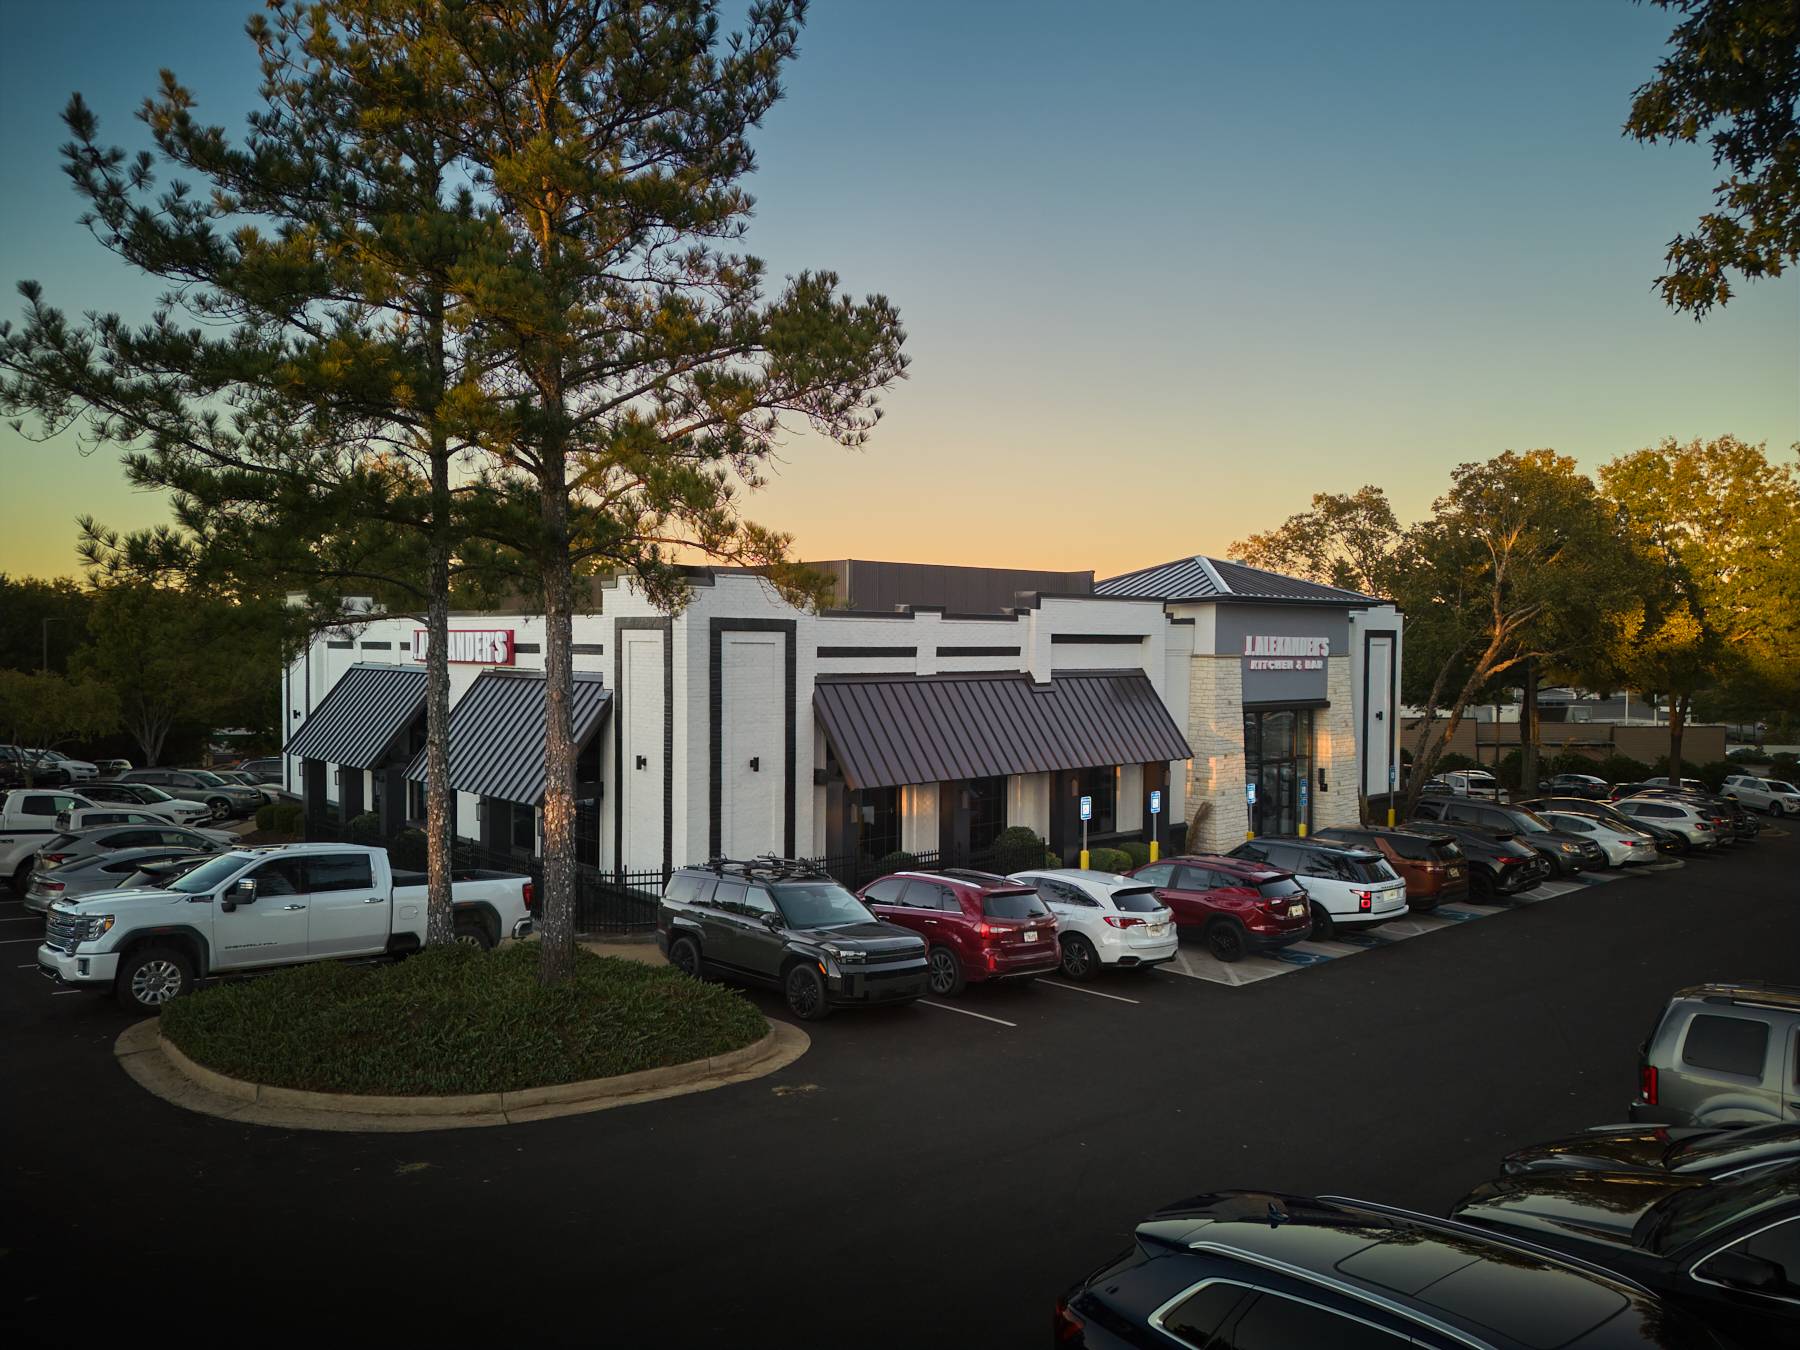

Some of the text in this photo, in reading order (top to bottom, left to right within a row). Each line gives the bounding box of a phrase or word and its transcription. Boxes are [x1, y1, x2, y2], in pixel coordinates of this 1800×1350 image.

[413, 630, 508, 664] J.AANDER'S
[1250, 659, 1324, 670] KITCHEN & BAR
